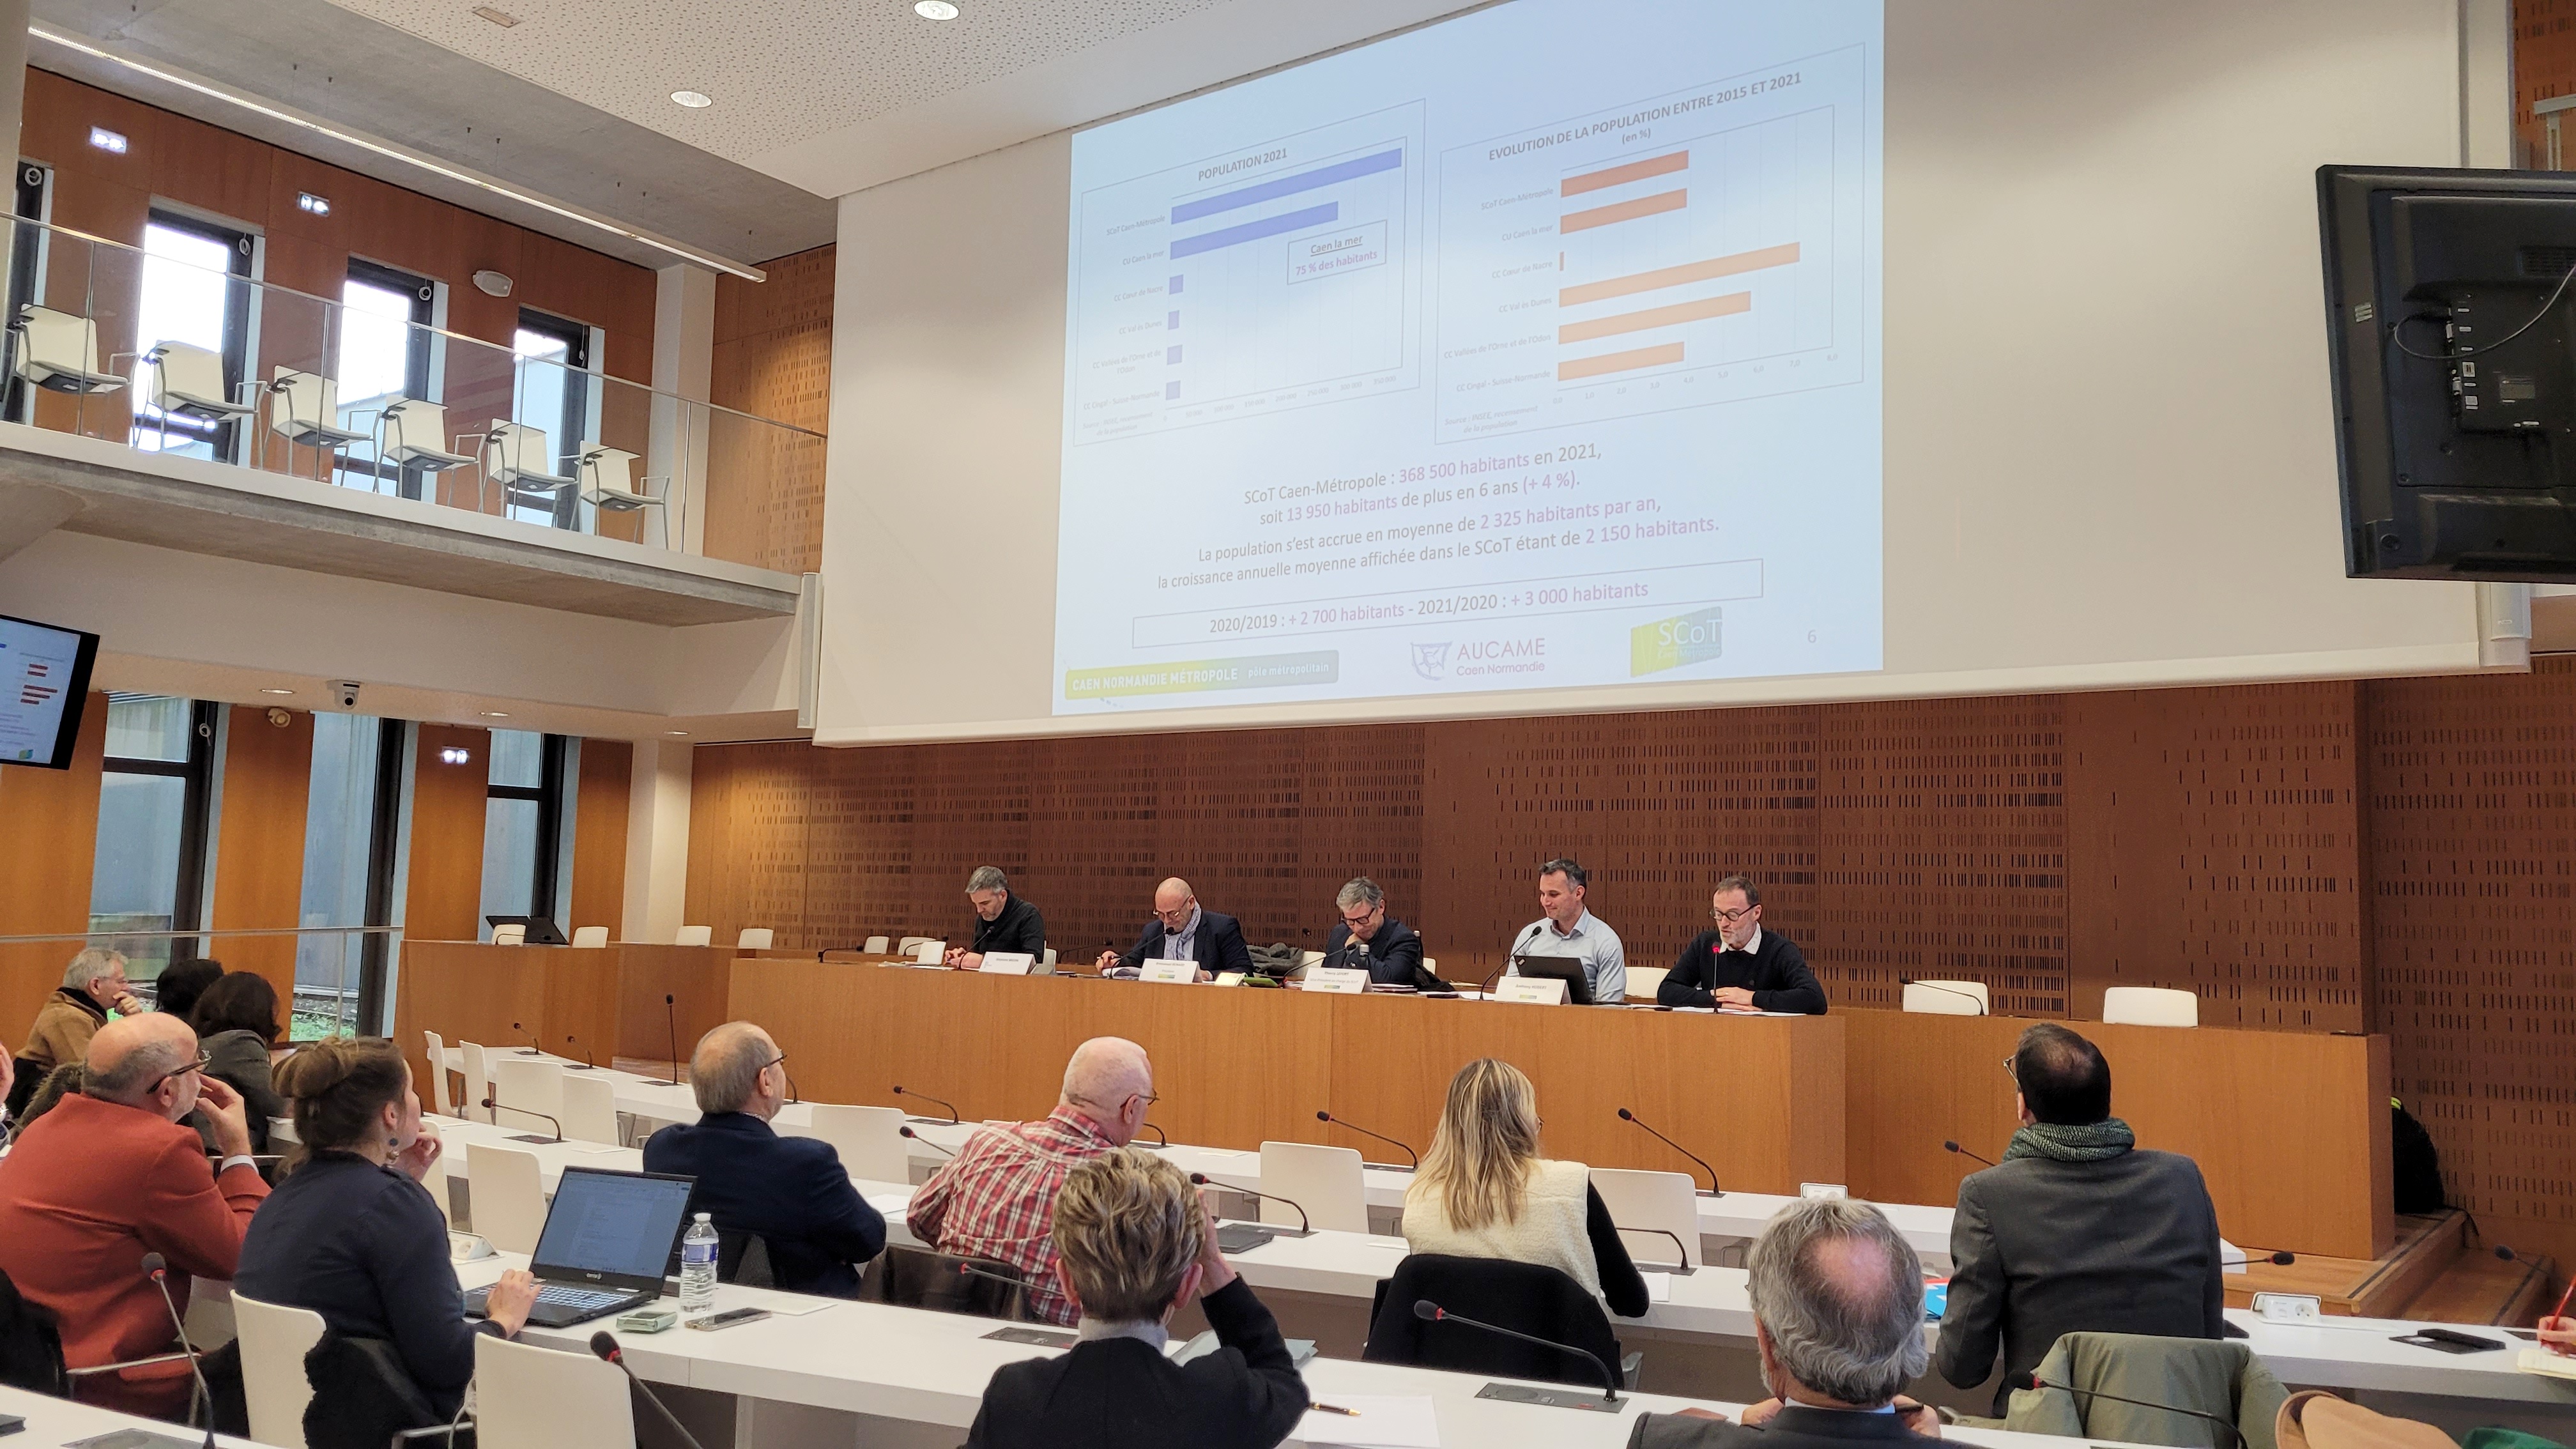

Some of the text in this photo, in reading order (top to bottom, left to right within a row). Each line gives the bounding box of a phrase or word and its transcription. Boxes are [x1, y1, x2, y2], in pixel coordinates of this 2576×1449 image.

[1489, 72, 1802, 161] EVOLUTION DE LA POPULATION ENTRE 2015 ET 2021
[1622, 127, 1652, 145] (en %)
[1199, 148, 1287, 181] POPULATION 2021
[1310, 234, 1363, 255] Caen la mer
[1296, 250, 1377, 276] 75 % des habitants
[1244, 487, 1276, 505] SCoT
[1278, 472, 1386, 499] Caen-Métropole
[1399, 467, 1425, 483] 368
[1429, 463, 1456, 479] 500
[1460, 454, 1529, 475] habitants
[1534, 452, 1552, 464] en
[1558, 443, 1602, 462] 2021,
[1260, 510, 1284, 525] soit
[1287, 507, 1302, 522] 13
[1307, 503, 1330, 519] 950
[1335, 496, 1397, 516] habitants
[1402, 492, 1418, 507] de
[1423, 489, 1452, 507] plus
[1457, 487, 1474, 500] en
[1480, 482, 1488, 496] 6
[1493, 481, 1518, 495] ans
[1542, 474, 1552, 489] 4
[1556, 470, 1580, 489] %).
[1199, 548, 1211, 562] La
[1216, 541, 1282, 562] population
[1318, 532, 1361, 548] accrue
[1366, 530, 1383, 542] en
[1388, 523, 1453, 540] moyenne
[1458, 516, 1475, 532] de
[1480, 514, 1489, 529] 2
[1494, 510, 1521, 528] 325
[1526, 503, 1600, 524] habitants
[1604, 500, 1631, 519] par
[1636, 498, 1661, 513] an,
[1158, 517, 1719, 589] la croissance annuelle moyenne affichée dans le SCoT étant de 2 150 habitants.
[1210, 614, 1277, 633] 2020/2019
[1300, 611, 1308, 625] 2
[1312, 609, 1337, 624] 700
[1340, 604, 1404, 622] habitants
[1418, 594, 1498, 615] 2021/2020
[1525, 591, 1534, 606] 3
[1538, 588, 1568, 604] 000
[1573, 582, 1649, 602] habitants
[1658, 618, 1722, 646] SCoT
[1807, 629, 1817, 643] 6
[1457, 638, 1545, 661] AUCAME
[1072, 663, 1329, 691] CAEN NORMANDIE MÉTROPOLE pôle métropolitain
[1457, 661, 1545, 676] Caen Normandie
